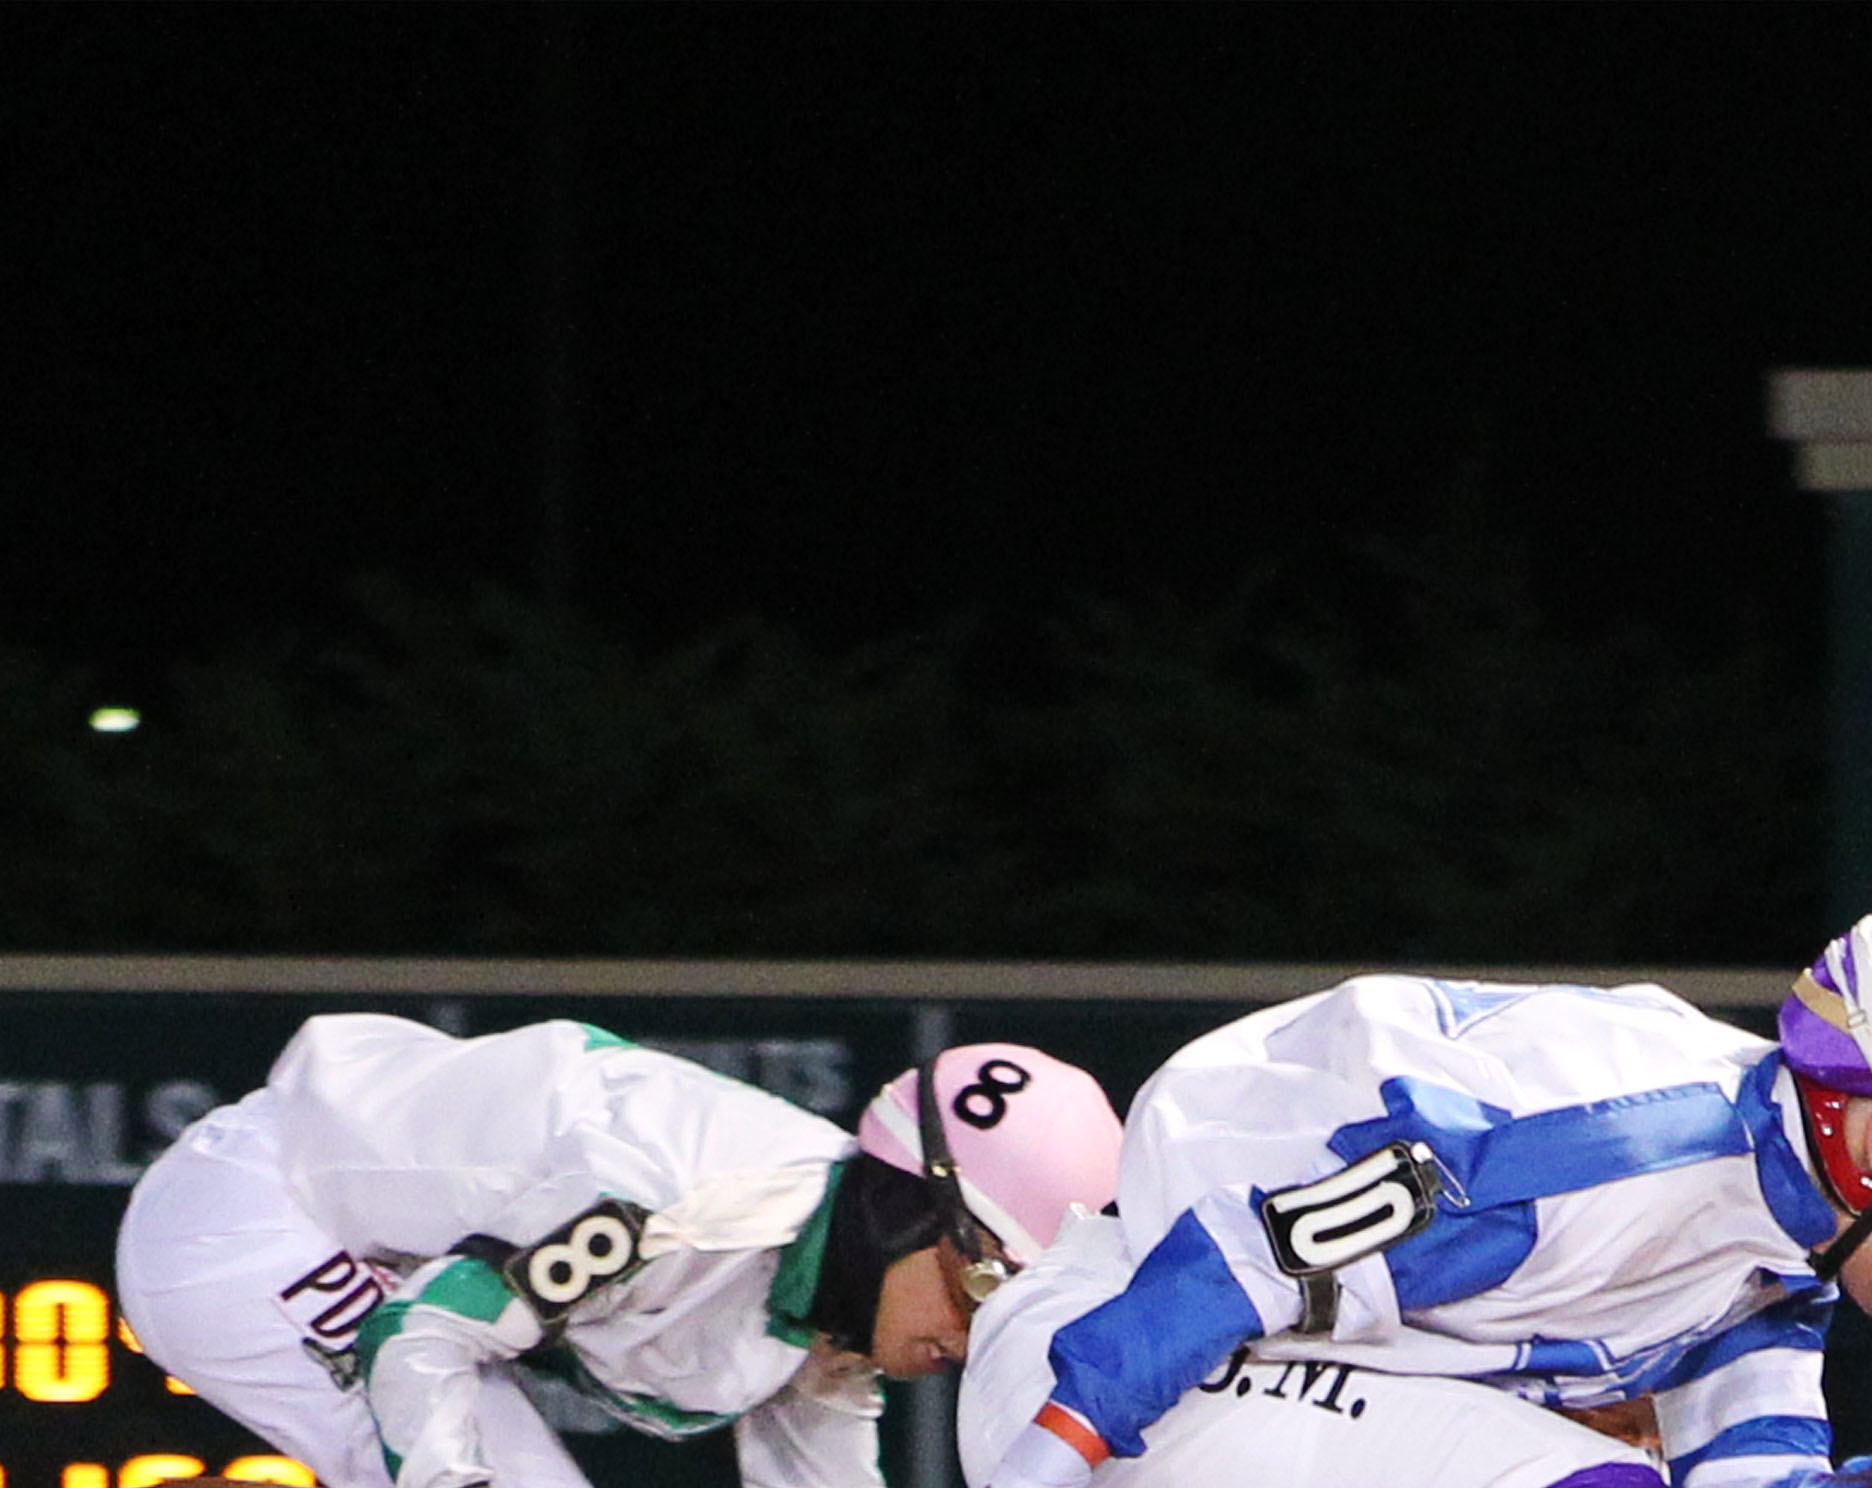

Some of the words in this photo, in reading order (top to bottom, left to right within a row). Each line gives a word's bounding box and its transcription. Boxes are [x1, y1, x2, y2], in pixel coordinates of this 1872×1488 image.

[953, 1058, 1031, 1130] 8
[1271, 1148, 1416, 1266] 10
[529, 1215, 632, 1304] 8
